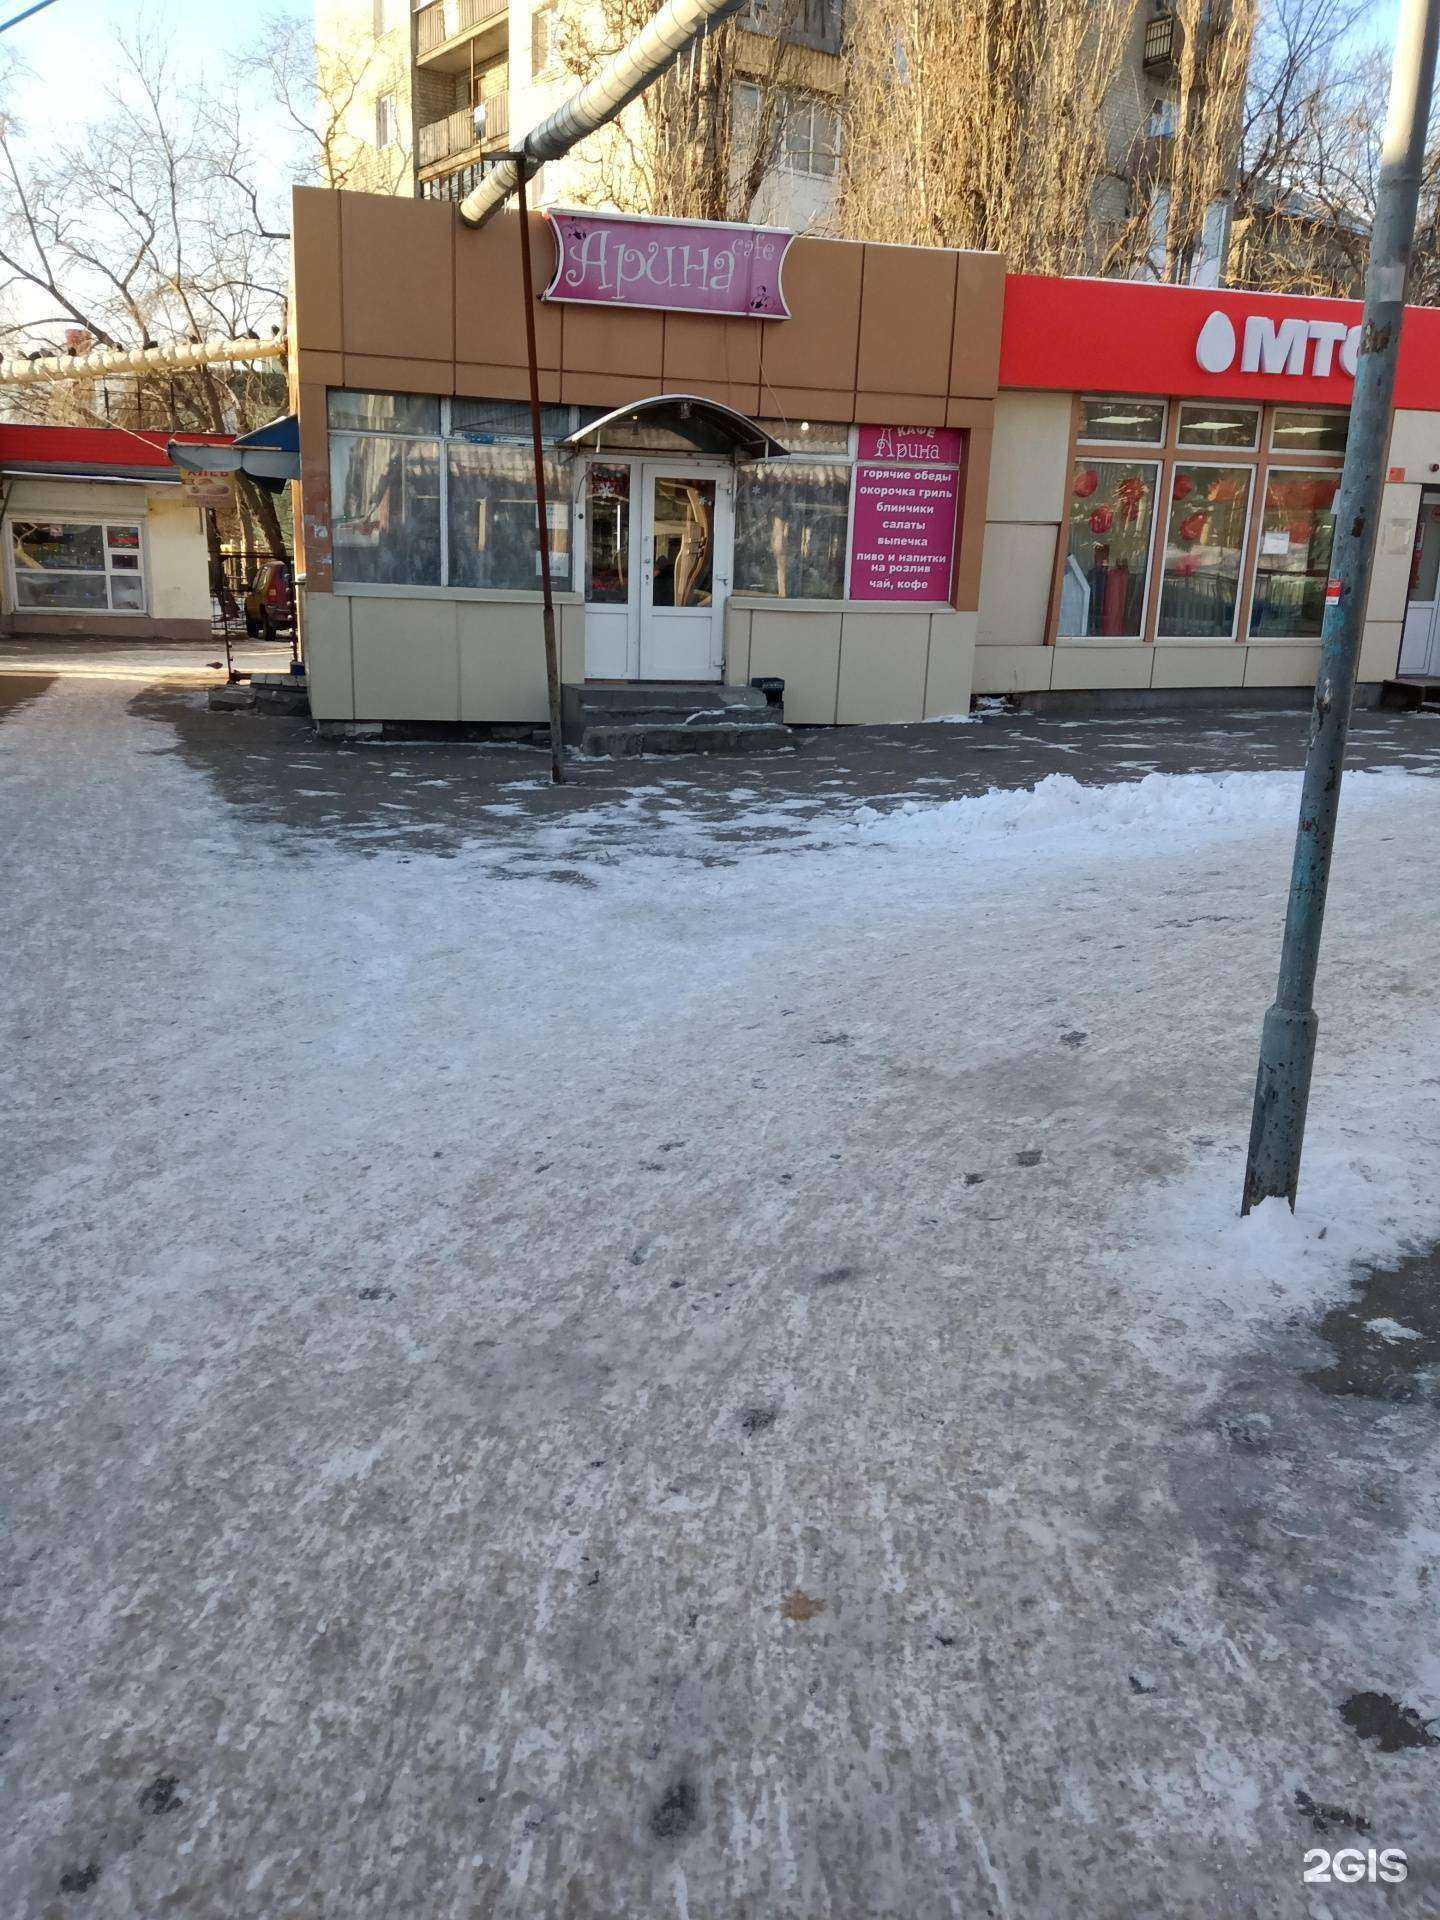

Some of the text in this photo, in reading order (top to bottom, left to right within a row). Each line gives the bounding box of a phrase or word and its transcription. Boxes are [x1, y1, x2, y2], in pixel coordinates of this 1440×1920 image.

[566, 231, 735, 299] Арина
[874, 427, 940, 460] Арина
[863, 469, 952, 482] горячие обеды
[860, 487, 953, 499] окорочка гриль
[876, 502, 934, 513] блинчики
[882, 521, 925, 530] салаты
[877, 537, 928, 546] выпечка
[856, 553, 947, 563] пиво и напитки
[871, 564, 931, 574] на розлив
[869, 579, 928, 591] чай, кофе
